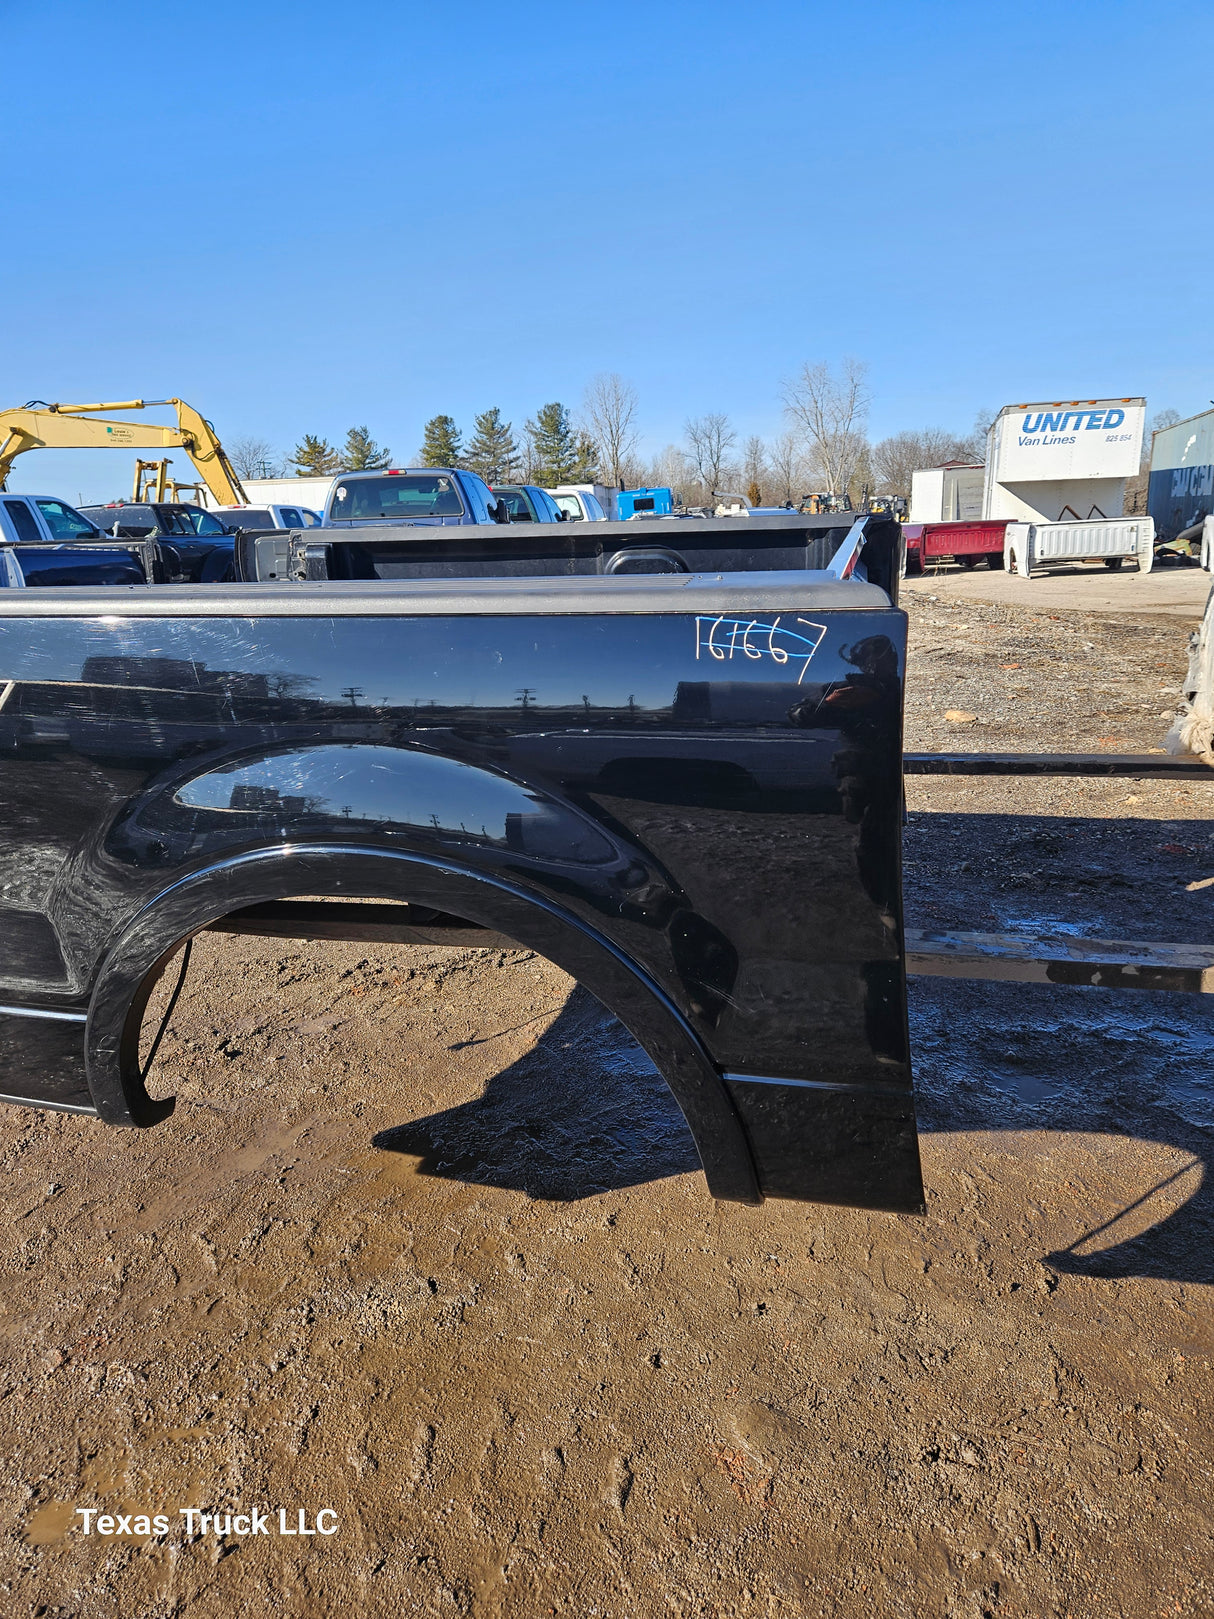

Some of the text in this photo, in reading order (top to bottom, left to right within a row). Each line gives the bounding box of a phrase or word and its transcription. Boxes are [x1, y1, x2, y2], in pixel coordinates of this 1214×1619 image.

[1022, 408, 1125, 433] UNITED
[1018, 434, 1076, 446] Van Lines
